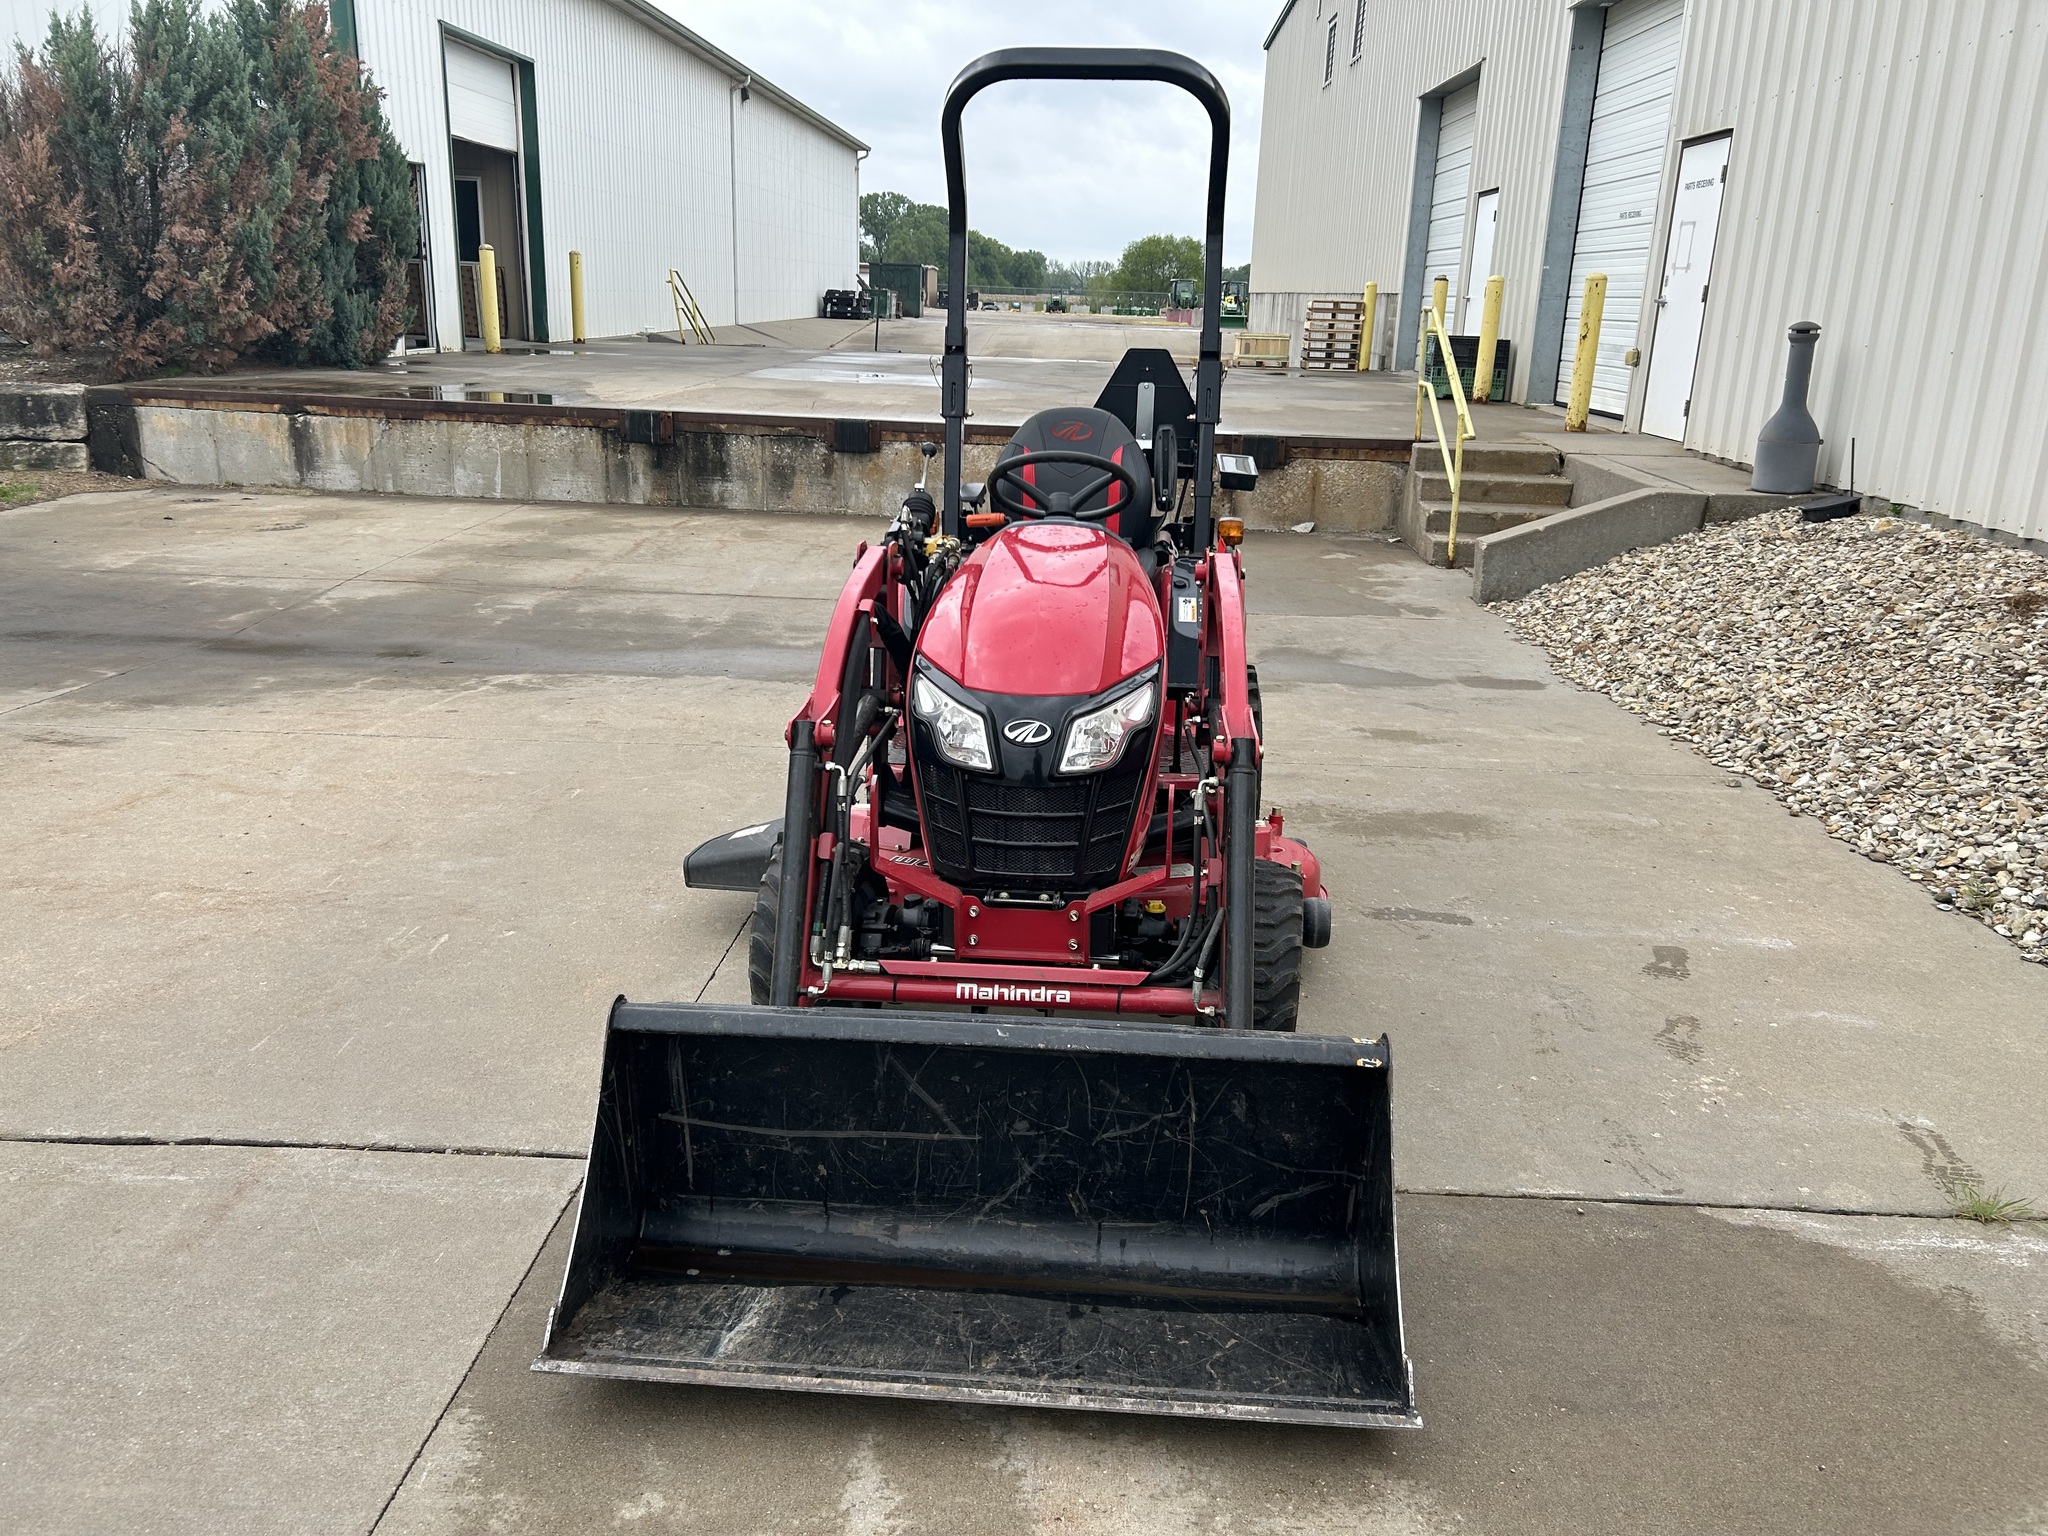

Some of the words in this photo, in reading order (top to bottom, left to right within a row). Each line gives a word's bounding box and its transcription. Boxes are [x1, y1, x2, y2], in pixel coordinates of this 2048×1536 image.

[1684, 181, 1696, 191] PARTS
[1696, 177, 1715, 189] RECEIVING
[956, 982, 1071, 1003] Mahindra
